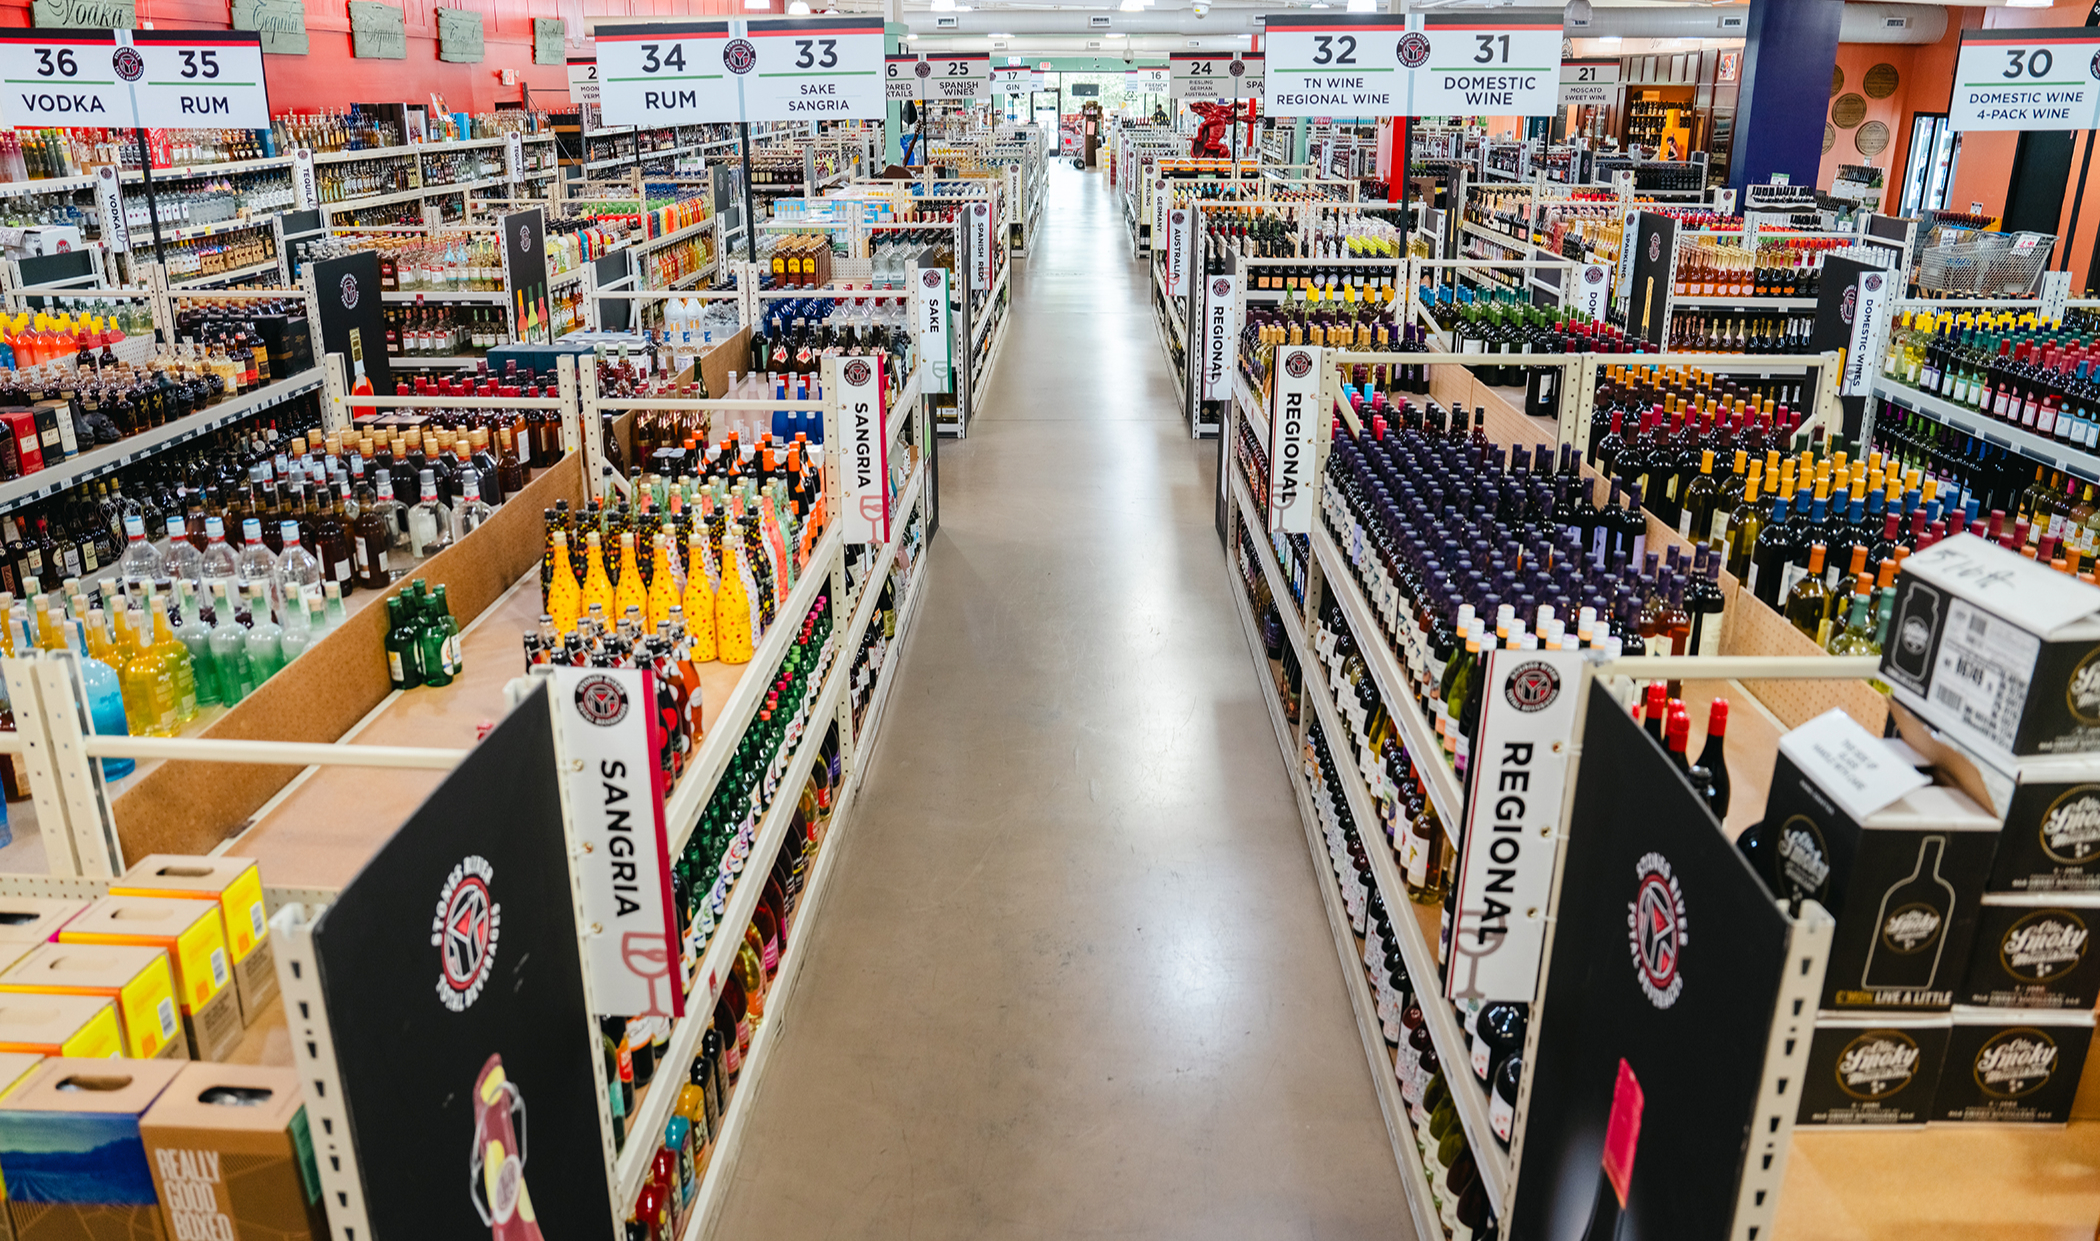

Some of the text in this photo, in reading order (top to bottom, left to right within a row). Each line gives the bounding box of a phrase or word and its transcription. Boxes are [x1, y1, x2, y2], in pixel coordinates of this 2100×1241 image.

[47, 0, 125, 28] Vodka
[33, 48, 78, 77] 36
[641, 43, 686, 73] 34
[795, 39, 838, 68] 33
[1312, 35, 1357, 64] 32
[1473, 34, 1510, 64] 31
[178, 50, 220, 78] 35
[887, 63, 898, 77] 6
[948, 62, 969, 76] 25
[1007, 71, 1017, 80] 17
[1150, 71, 1162, 80] 16
[1190, 61, 1213, 75] 24
[1578, 67, 1597, 81] 21
[2002, 48, 2053, 78] 30
[800, 84, 836, 95] SAKE
[939, 81, 979, 90] SPANISH
[943, 88, 975, 96] WINES
[1005, 83, 1020, 91] GIN
[1303, 77, 1364, 89] TN WINE
[1444, 76, 1537, 91] DOMESTIC
[21, 94, 106, 113] VODKA
[180, 96, 230, 114] RUM
[645, 90, 697, 109] RUM
[788, 100, 850, 112] SANGRIA
[1276, 93, 1390, 106] REGIONAL WINE
[1465, 92, 1513, 106] WINE
[1969, 91, 2084, 104] DOMESTIC WINE
[1976, 108, 2070, 120] 4-PACK WINE
[301, 167, 314, 204] TEQUILA
[108, 193, 122, 231] VODKA
[1173, 228, 1181, 280] AUSTRALIA
[1620, 232, 1632, 279] SPARKLING
[977, 261, 985, 283] REDS
[929, 298, 939, 333] SAKE
[1211, 306, 1224, 381] REGIONAL
[1852, 299, 1874, 387] DOMESTIC WINES
[854, 402, 872, 489] SANGRIA
[1281, 392, 1302, 504] REGIONAL
[600, 758, 640, 919] SANGRIA
[1478, 741, 1535, 946] REGIONAL
[2004, 927, 2090, 956] Smoky
[1875, 991, 1901, 1005] LIVE
[1901, 991, 1912, 1004] A
[1912, 991, 1953, 1005] LITTLE
[1839, 1046, 1920, 1073] Smoky
[1977, 1045, 2058, 1072] Smoky
[155, 1148, 220, 1184] REALLY
[163, 1180, 218, 1214] GOOD
[171, 1212, 234, 1241] BOXED
